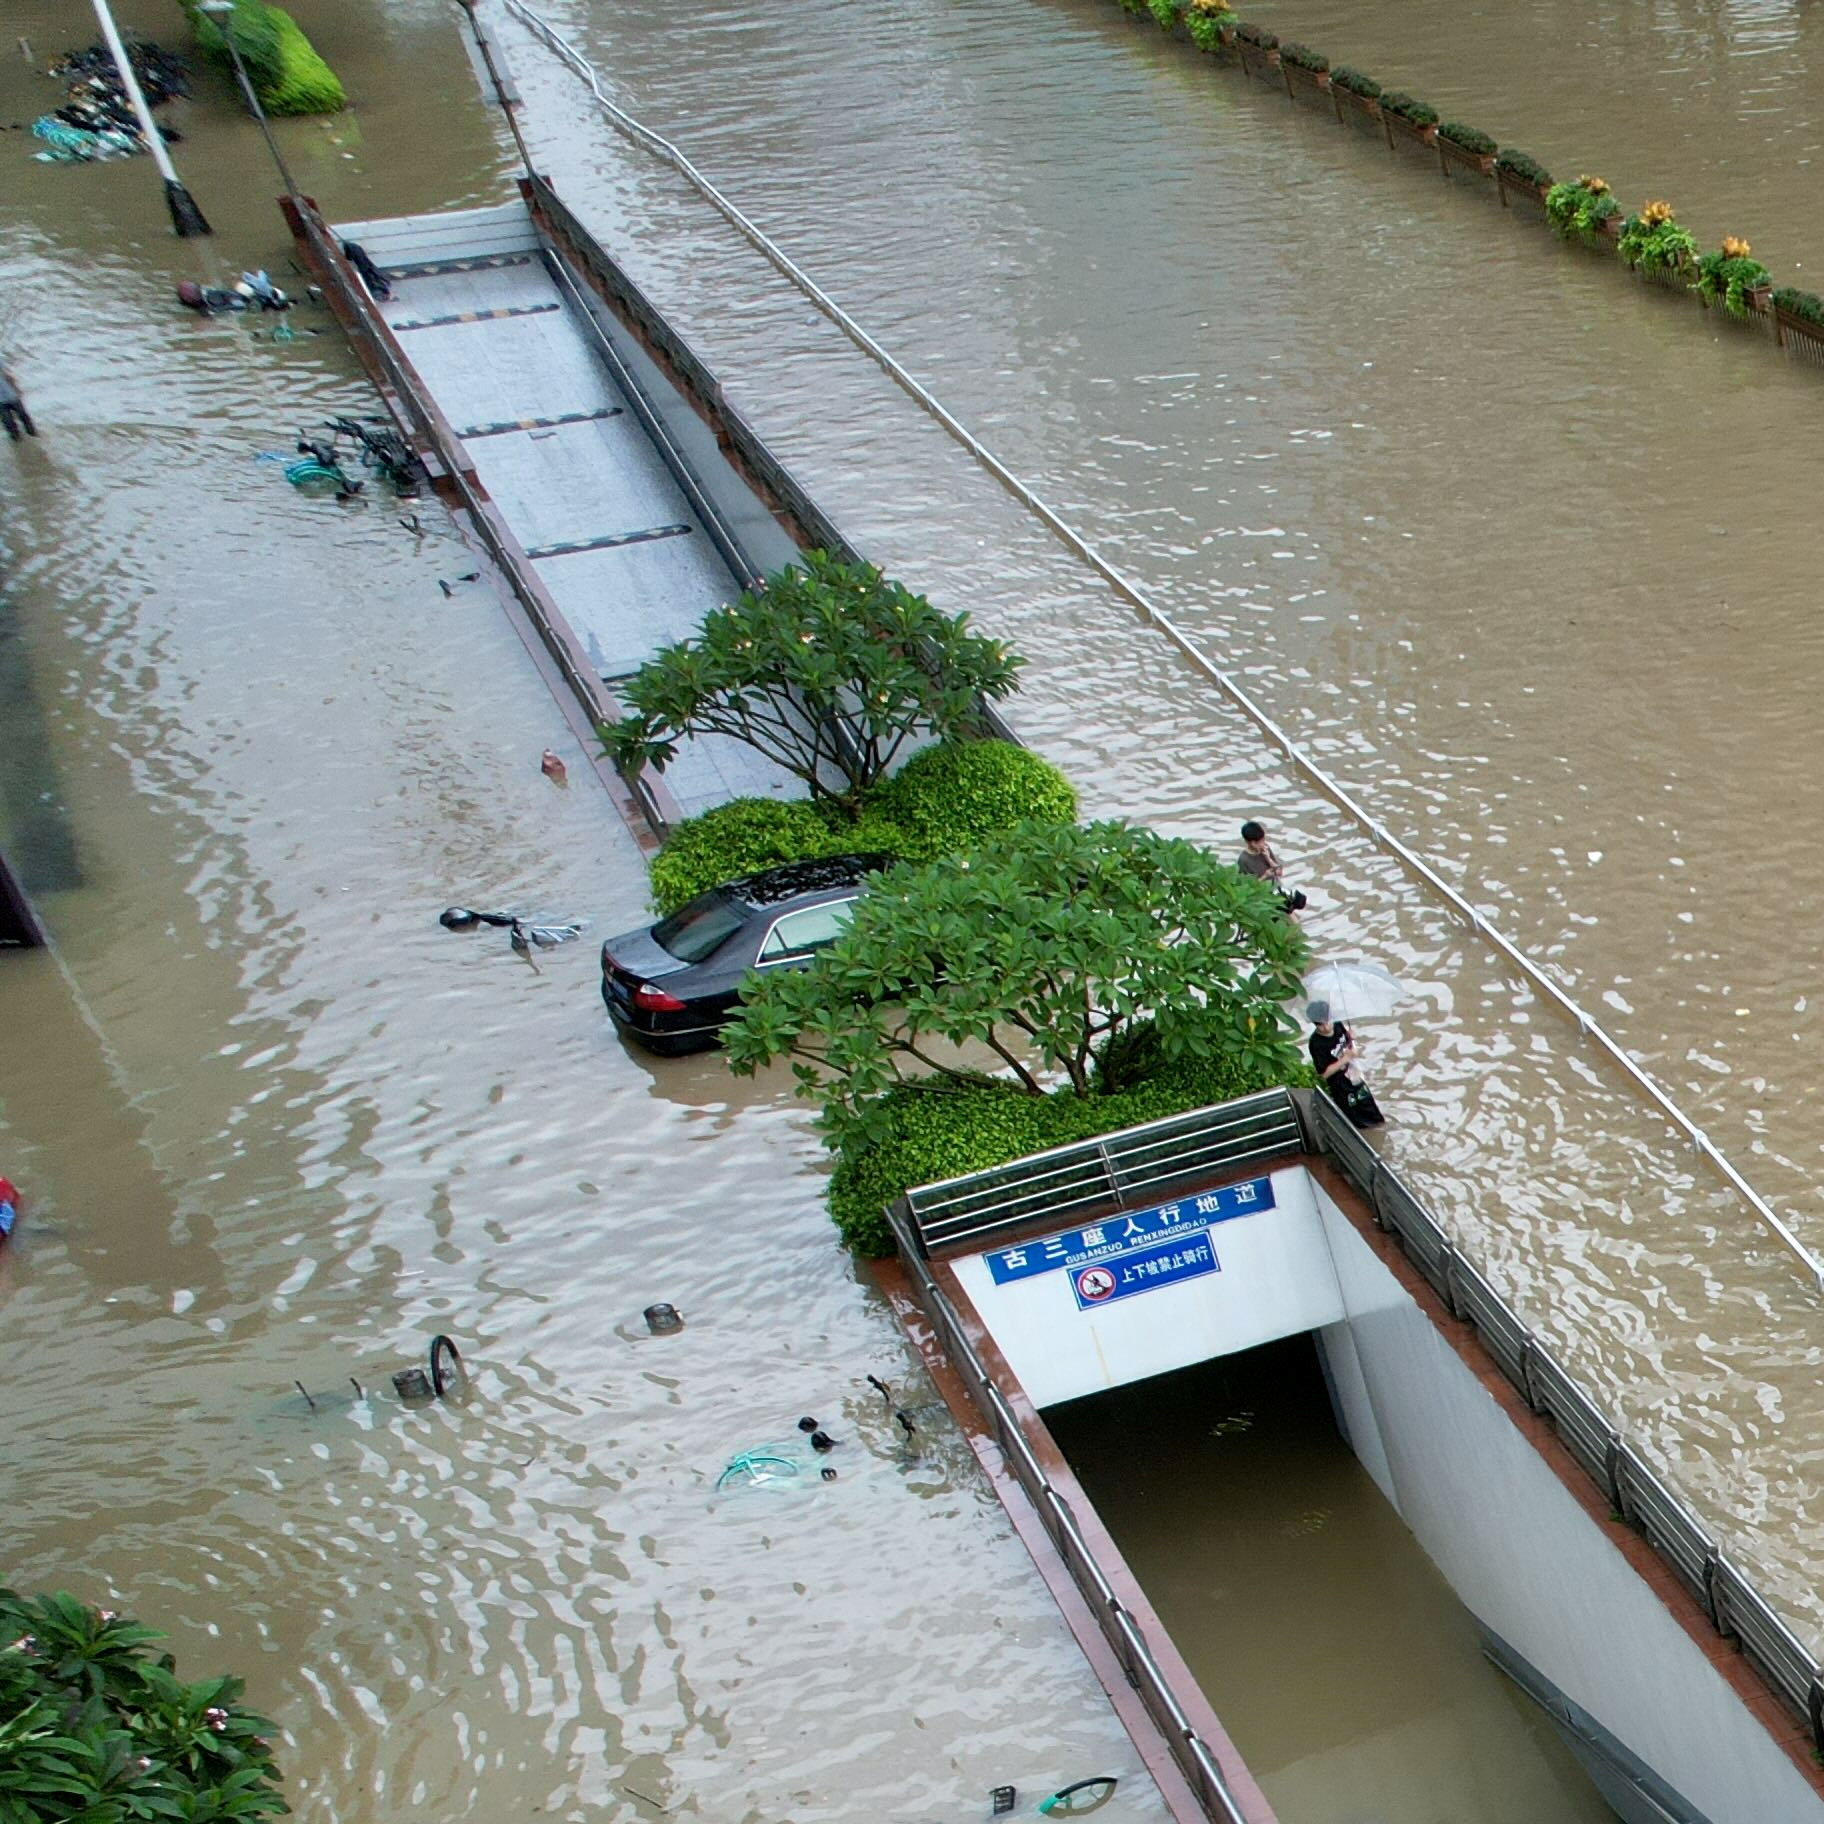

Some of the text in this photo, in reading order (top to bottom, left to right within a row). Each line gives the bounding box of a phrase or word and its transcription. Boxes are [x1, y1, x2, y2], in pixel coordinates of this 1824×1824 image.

[1002, 1184, 1258, 1270] 古三座人行地道
[1065, 1217, 1208, 1265] GUSANZUO RENXINGDIDAO
